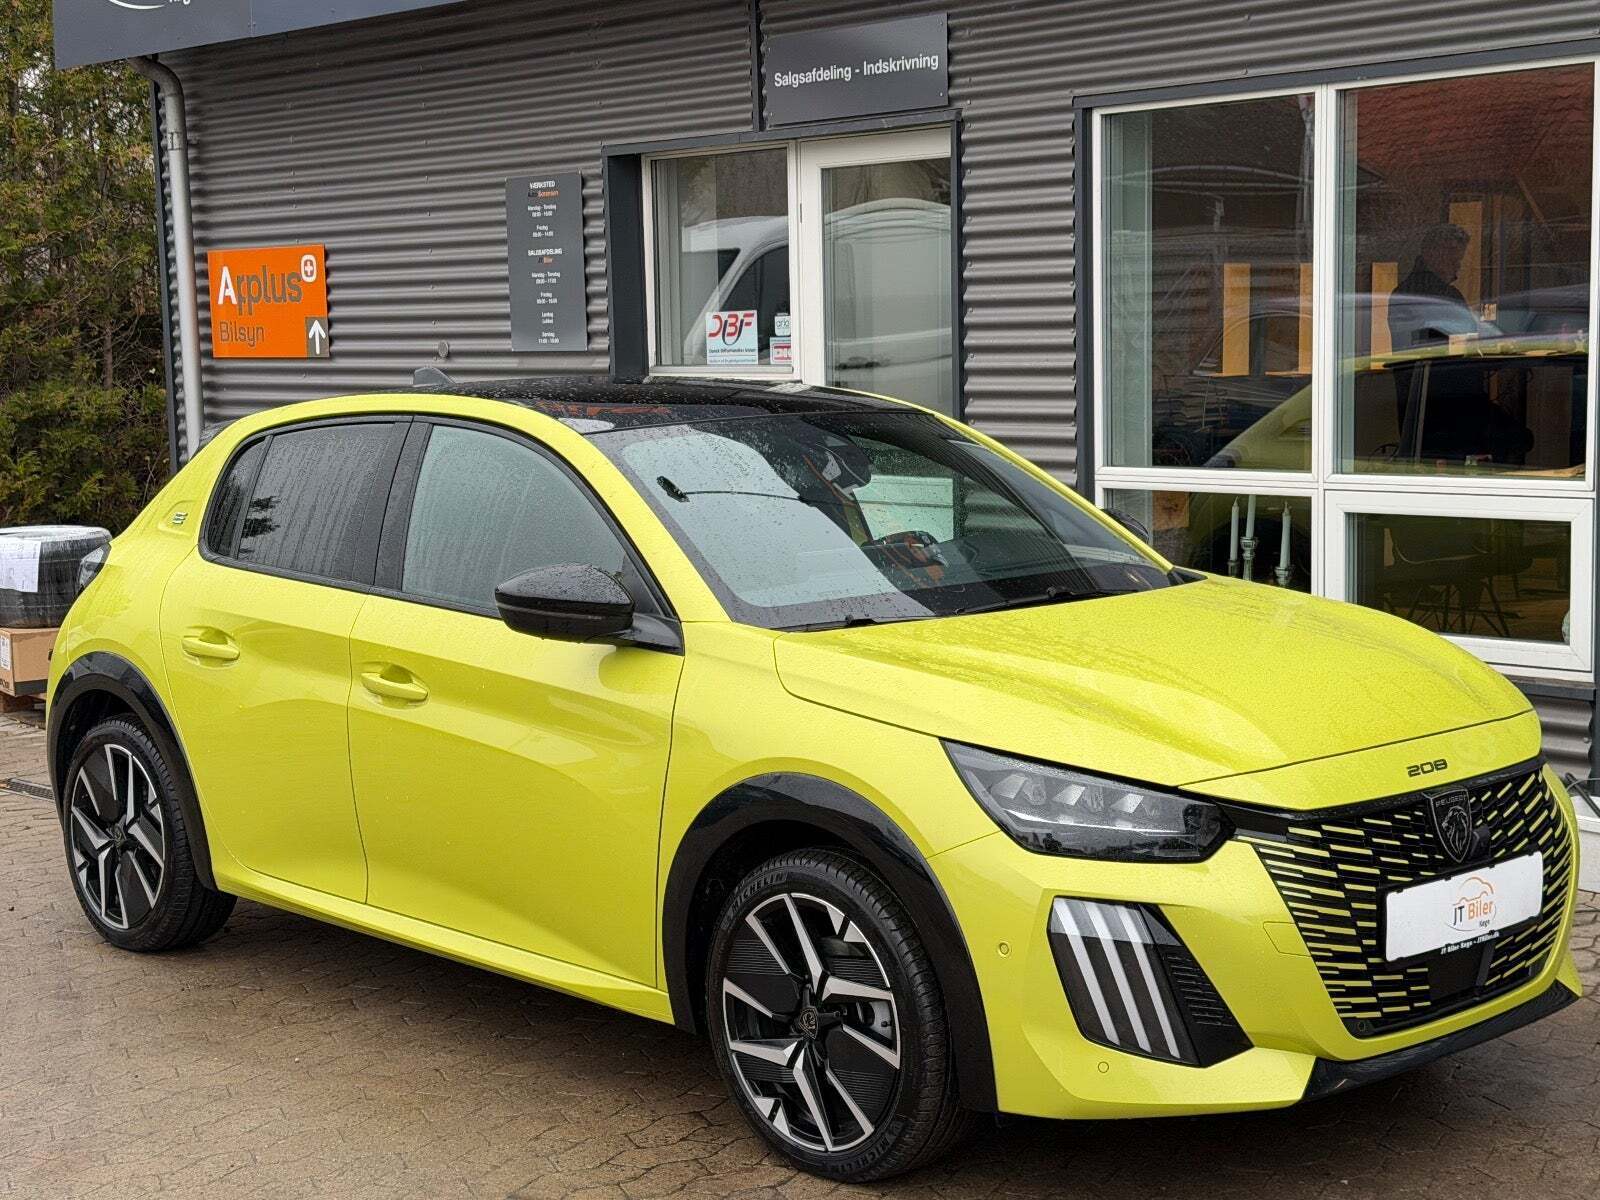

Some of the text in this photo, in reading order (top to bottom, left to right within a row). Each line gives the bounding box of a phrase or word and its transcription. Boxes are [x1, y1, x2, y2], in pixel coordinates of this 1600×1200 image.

[774, 64, 852, 88] Salgsafdeling
[863, 53, 939, 76] Indskrivning
[219, 320, 265, 347] Bilsyn
[1406, 758, 1448, 779] 208
[1434, 794, 1468, 808] PEUGEOT
[731, 870, 786, 913] MICHELIN
[1452, 900, 1494, 926] JT Biler
